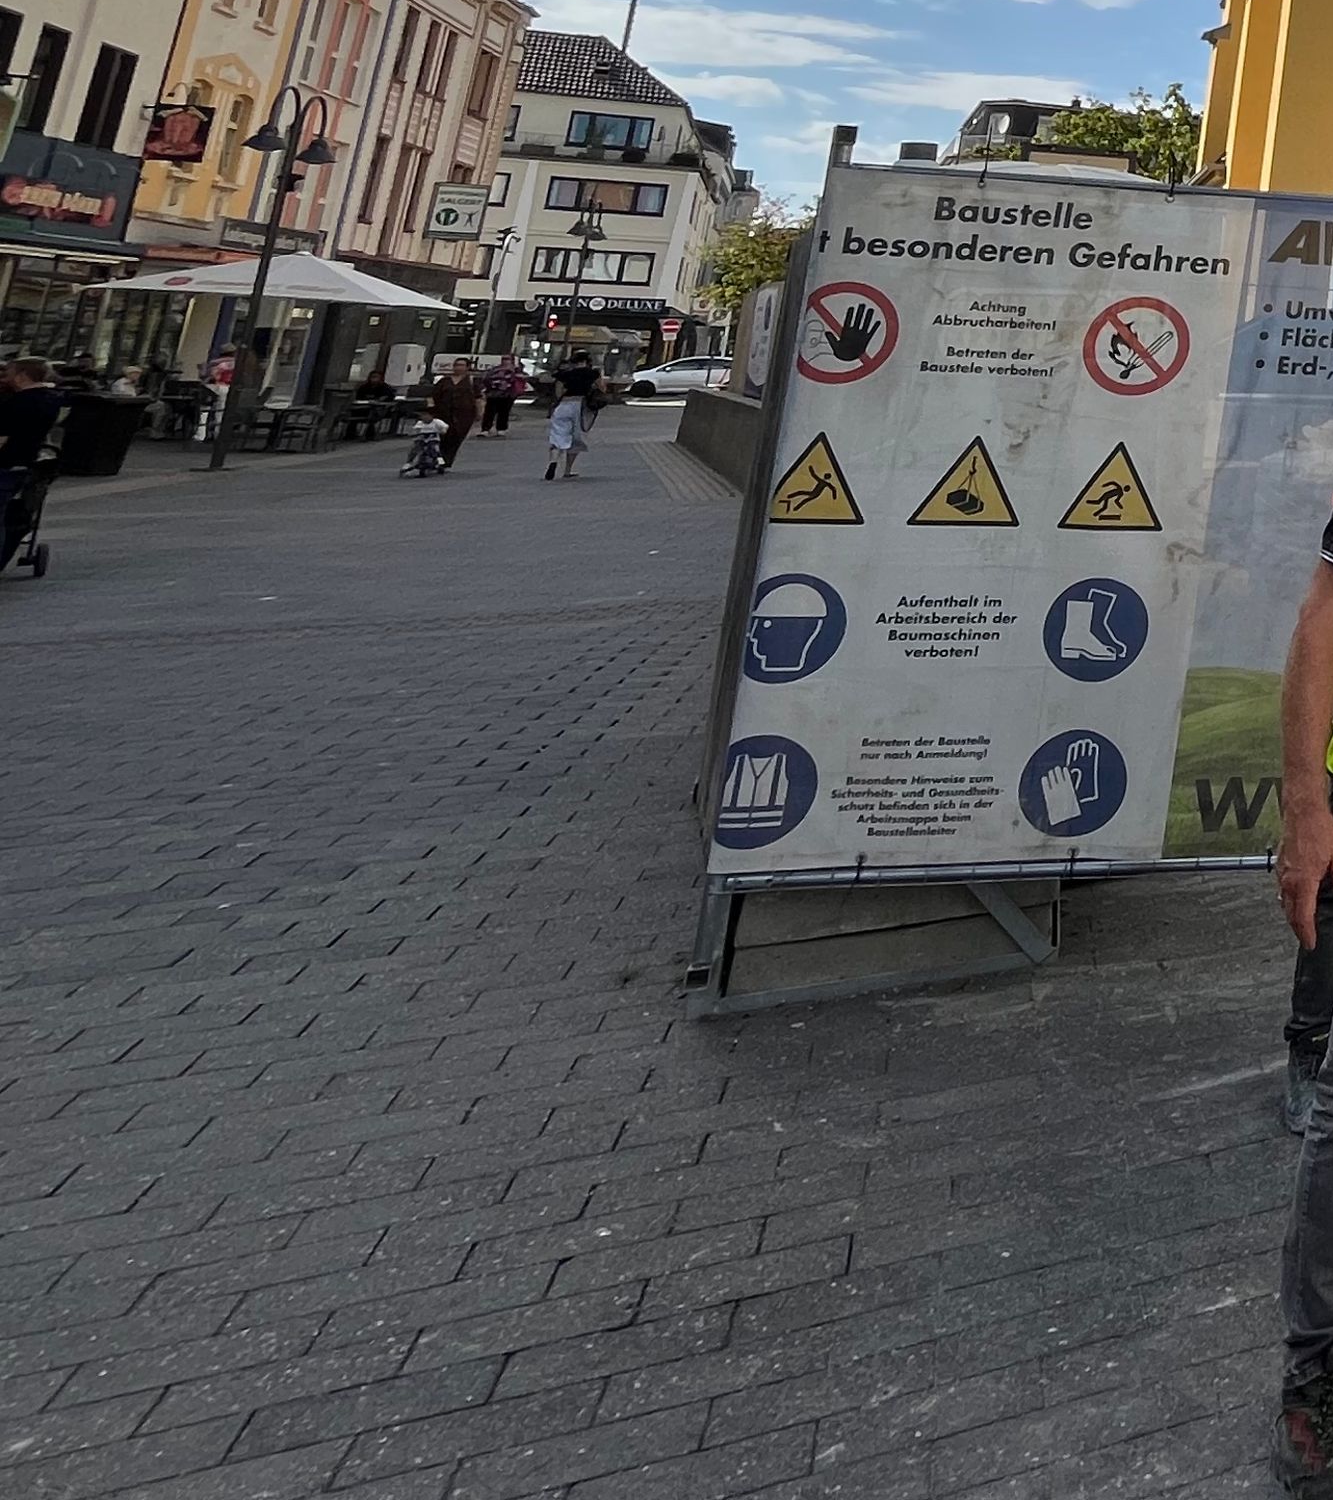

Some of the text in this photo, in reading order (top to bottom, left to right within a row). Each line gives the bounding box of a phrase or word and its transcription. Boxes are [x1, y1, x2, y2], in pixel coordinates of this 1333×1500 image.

[933, 196, 1094, 230] Baustelle
[819, 226, 1231, 276] t besonderen Gefahren
[607, 298, 664, 311] DELUXE
[969, 301, 1027, 316] Achtung
[932, 315, 1057, 331] Abbrucharbeiten!
[946, 346, 1035, 361] Betreten der
[920, 361, 1054, 378] Baustele verboten!
[896, 595, 1002, 608] Aufenthalt im
[875, 612, 1018, 625] Arbeitsbereich der
[887, 628, 1001, 642] Baumaschinen
[904, 645, 980, 658] verboten!
[861, 735, 991, 747] Betreten der Baustelle
[860, 748, 988, 760] nur nach Anmeldung!
[845, 775, 994, 786] Besondere Hinweise zum
[831, 788, 898, 799] Sicherheits-
[901, 788, 925, 798] und
[837, 799, 994, 812] schutz befinden sich in der
[856, 813, 971, 826] Arbeitsmappe beim
[866, 826, 958, 837] Baustellenleiter
